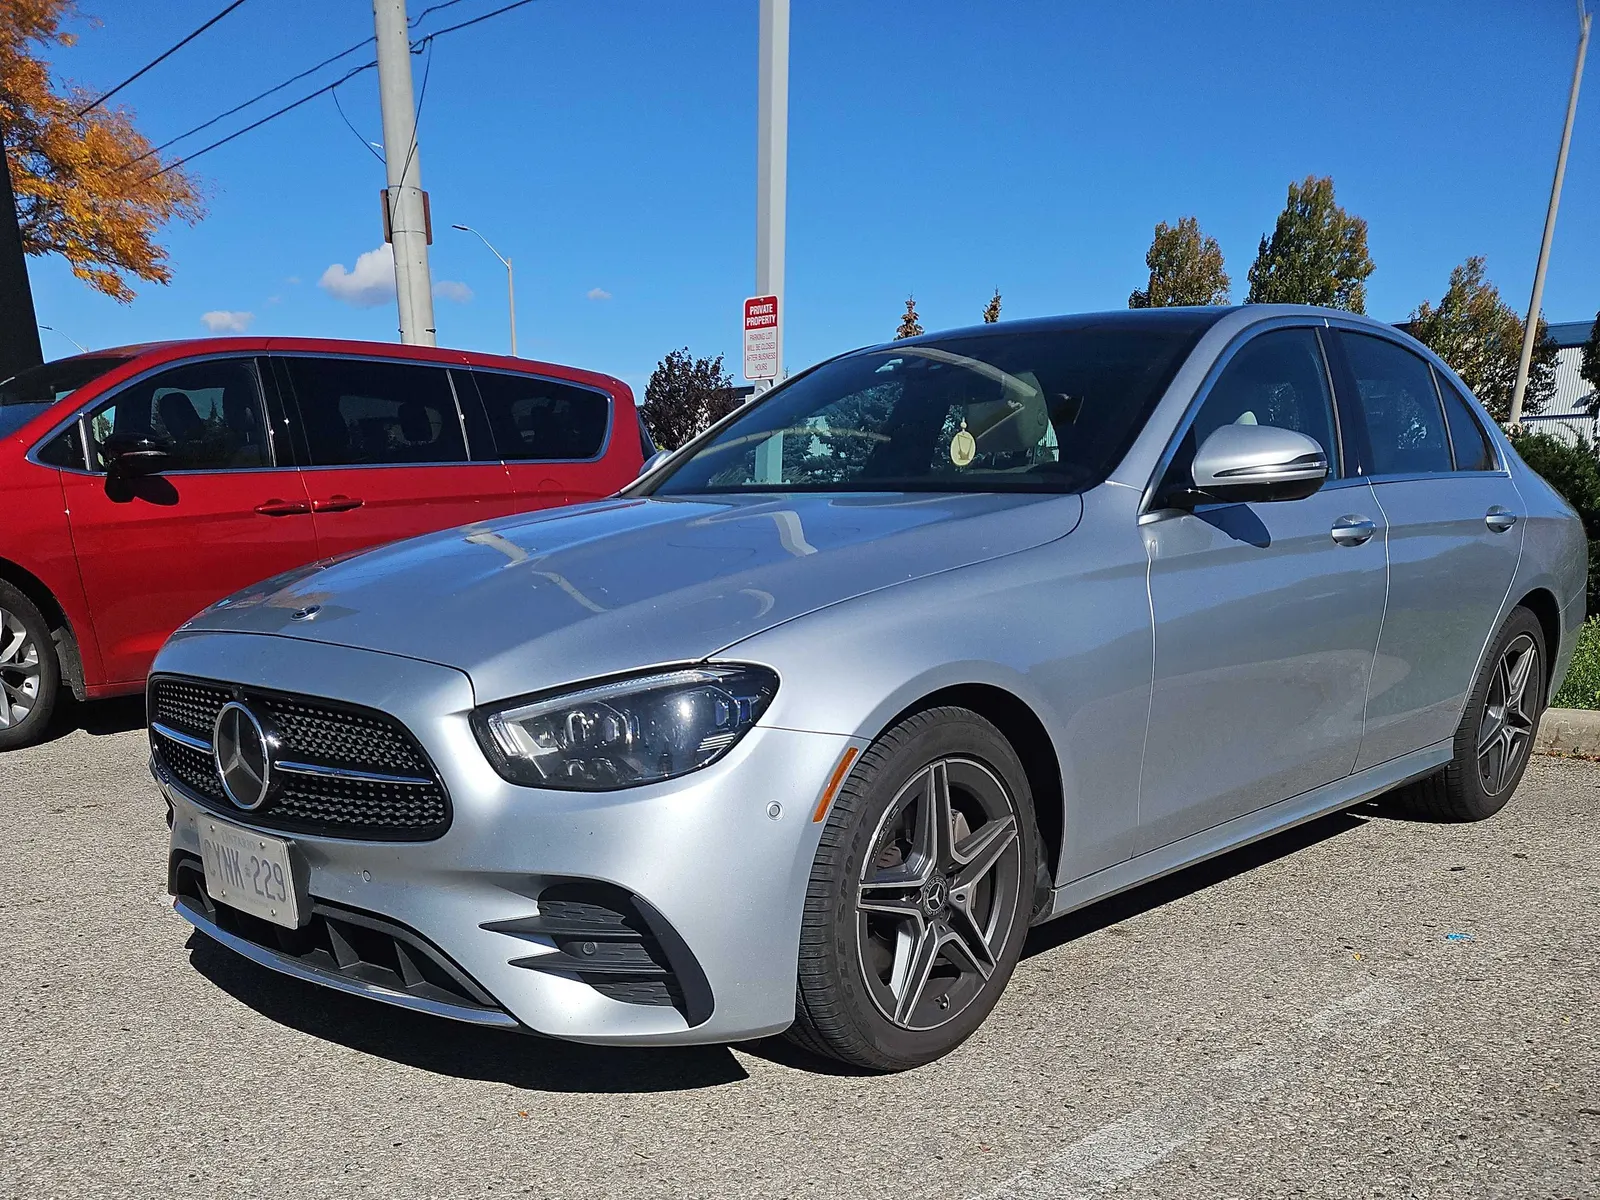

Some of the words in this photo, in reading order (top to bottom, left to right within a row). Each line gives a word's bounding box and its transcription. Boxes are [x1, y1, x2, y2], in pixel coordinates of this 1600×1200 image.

[749, 304, 773, 316] PRIVATE
[746, 314, 776, 327] PROPERTY
[761, 342, 775, 350] CLOSED
[758, 352, 776, 361] BUSINESS
[755, 362, 768, 370] HOURS
